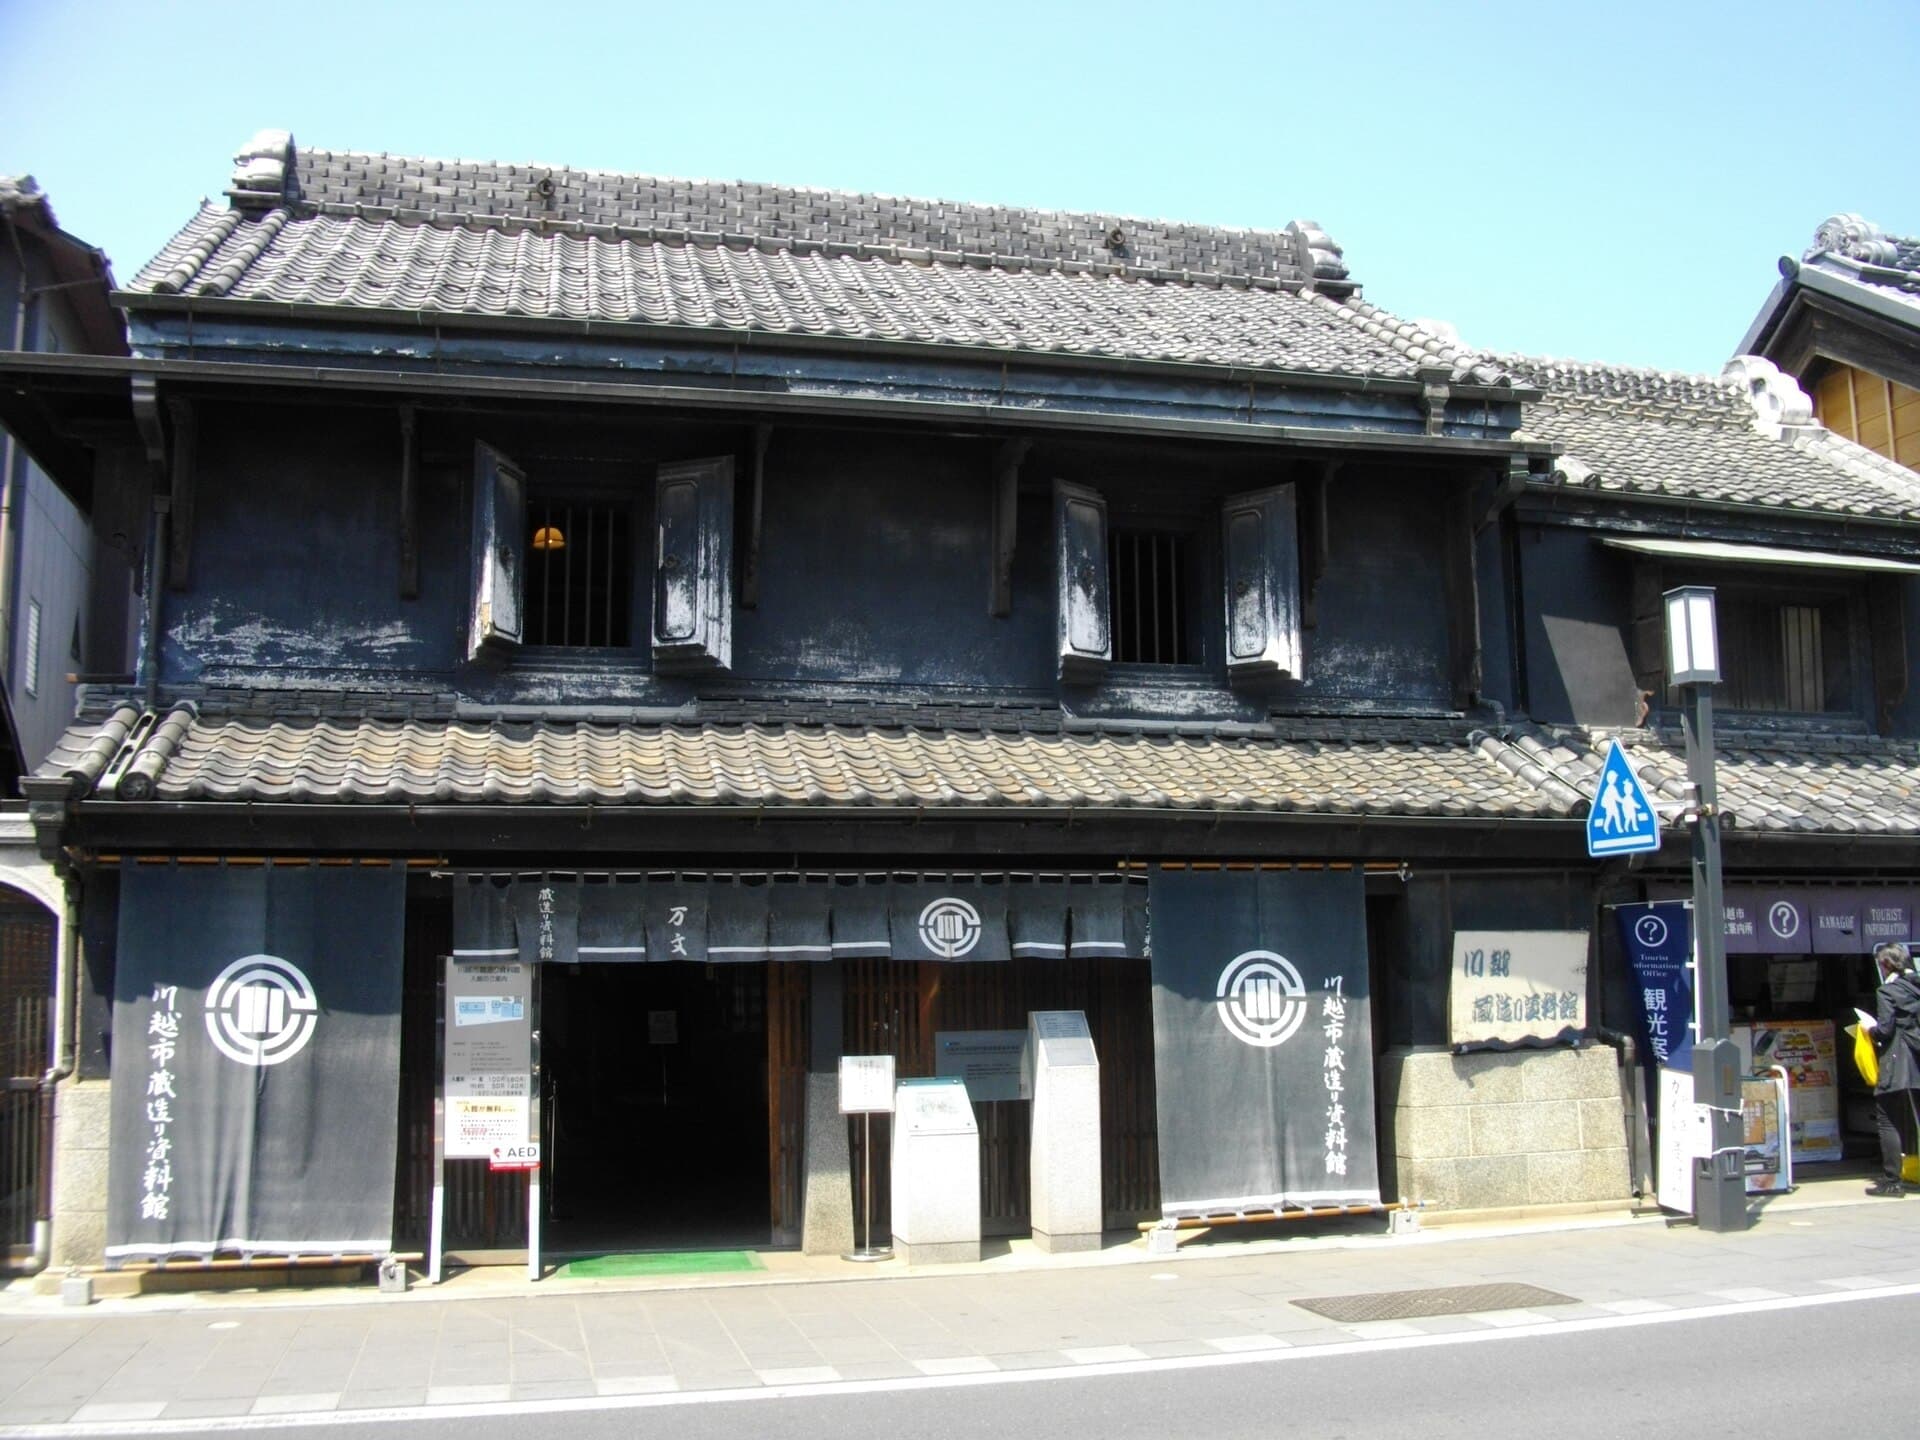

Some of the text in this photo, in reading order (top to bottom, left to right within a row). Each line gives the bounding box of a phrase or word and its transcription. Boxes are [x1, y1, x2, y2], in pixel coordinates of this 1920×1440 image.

[1871, 908, 1903, 921] TOURIST
[1819, 915, 1855, 929] KAWAGOE
[668, 906, 688, 956] 万文
[1864, 923, 1909, 937] INFORMATION
[1640, 953, 1669, 961] Tourist
[1322, 975, 1347, 1175] 川越市蔵造り資料館
[141, 985, 181, 1220] 川越市蔵造り資料館
[507, 1147, 537, 1157] AED
